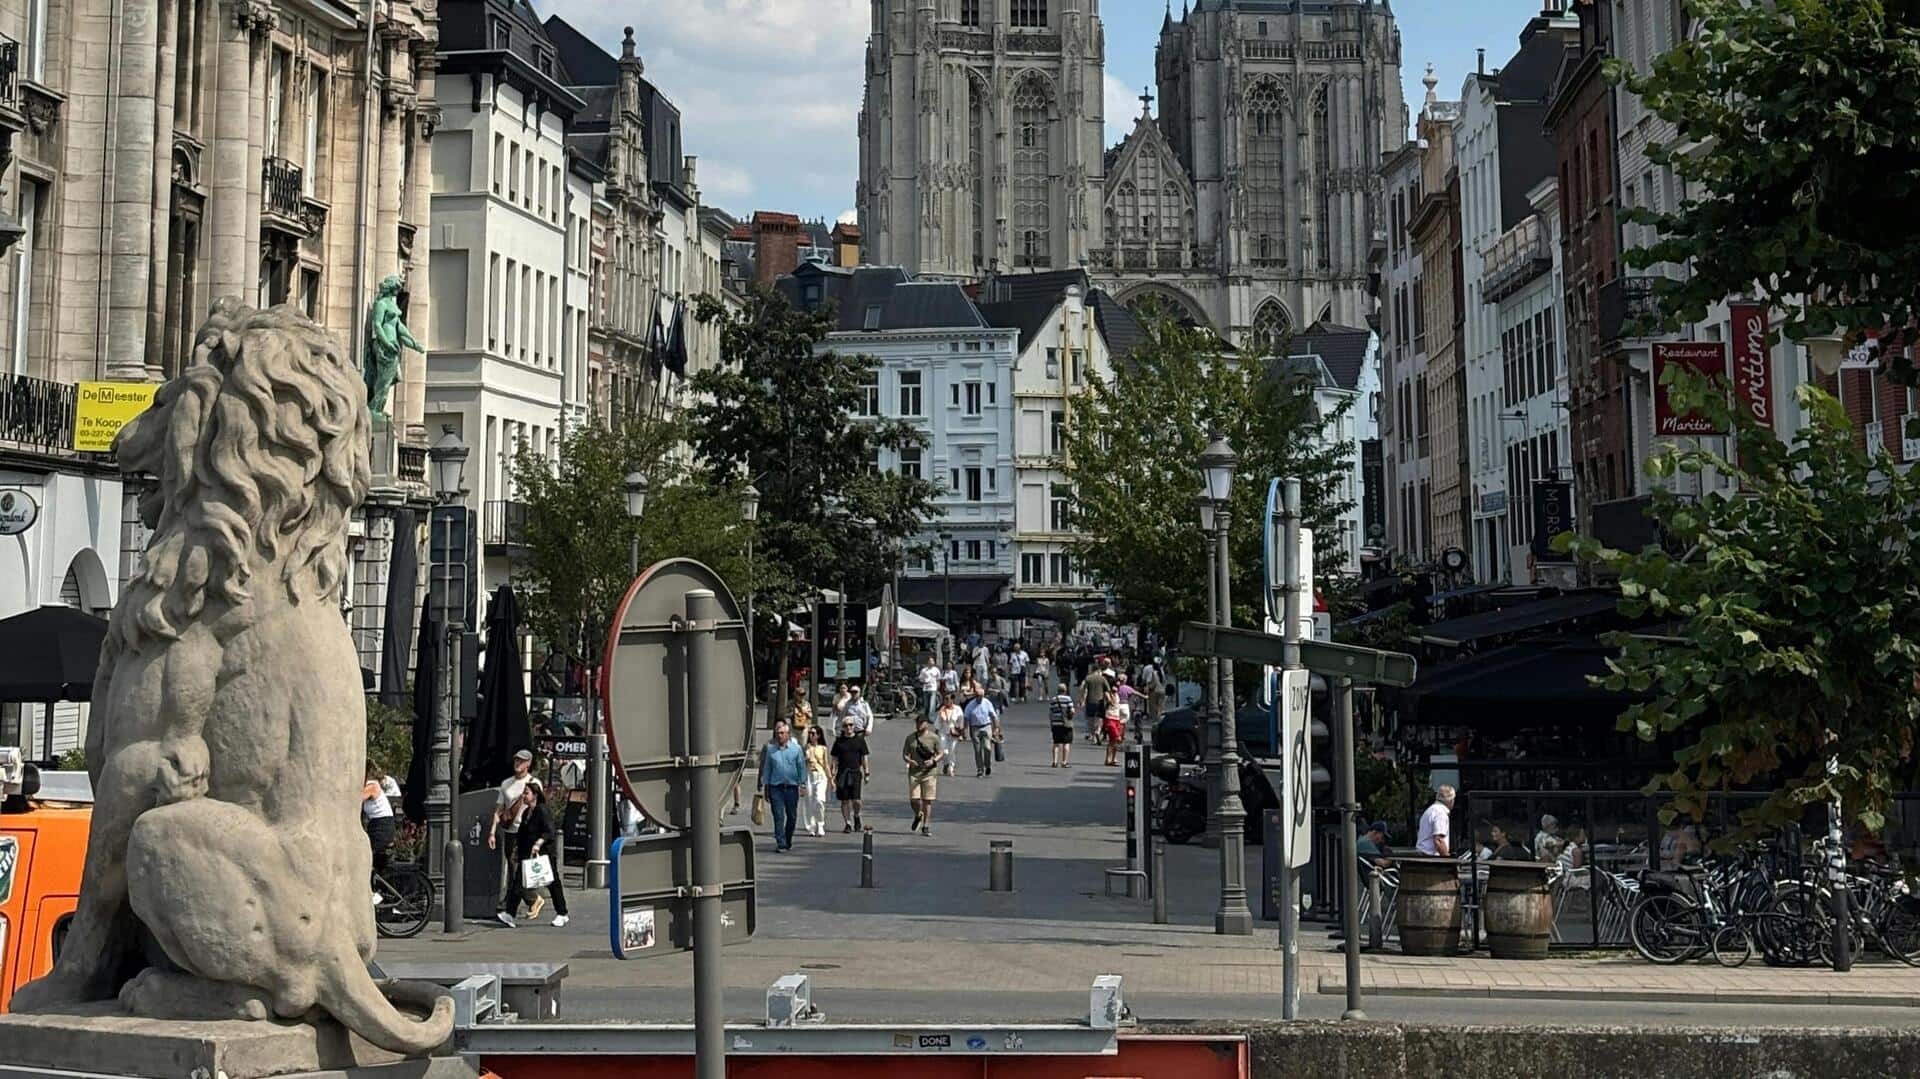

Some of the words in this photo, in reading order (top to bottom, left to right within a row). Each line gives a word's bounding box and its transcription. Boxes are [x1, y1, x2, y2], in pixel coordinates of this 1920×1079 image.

[1657, 344, 1720, 359] Restaurant
[80, 416, 93, 428] Te
[95, 416, 122, 430] Koop
[1662, 416, 1714, 432] Maritim
[921, 1035, 949, 1047] DONE
